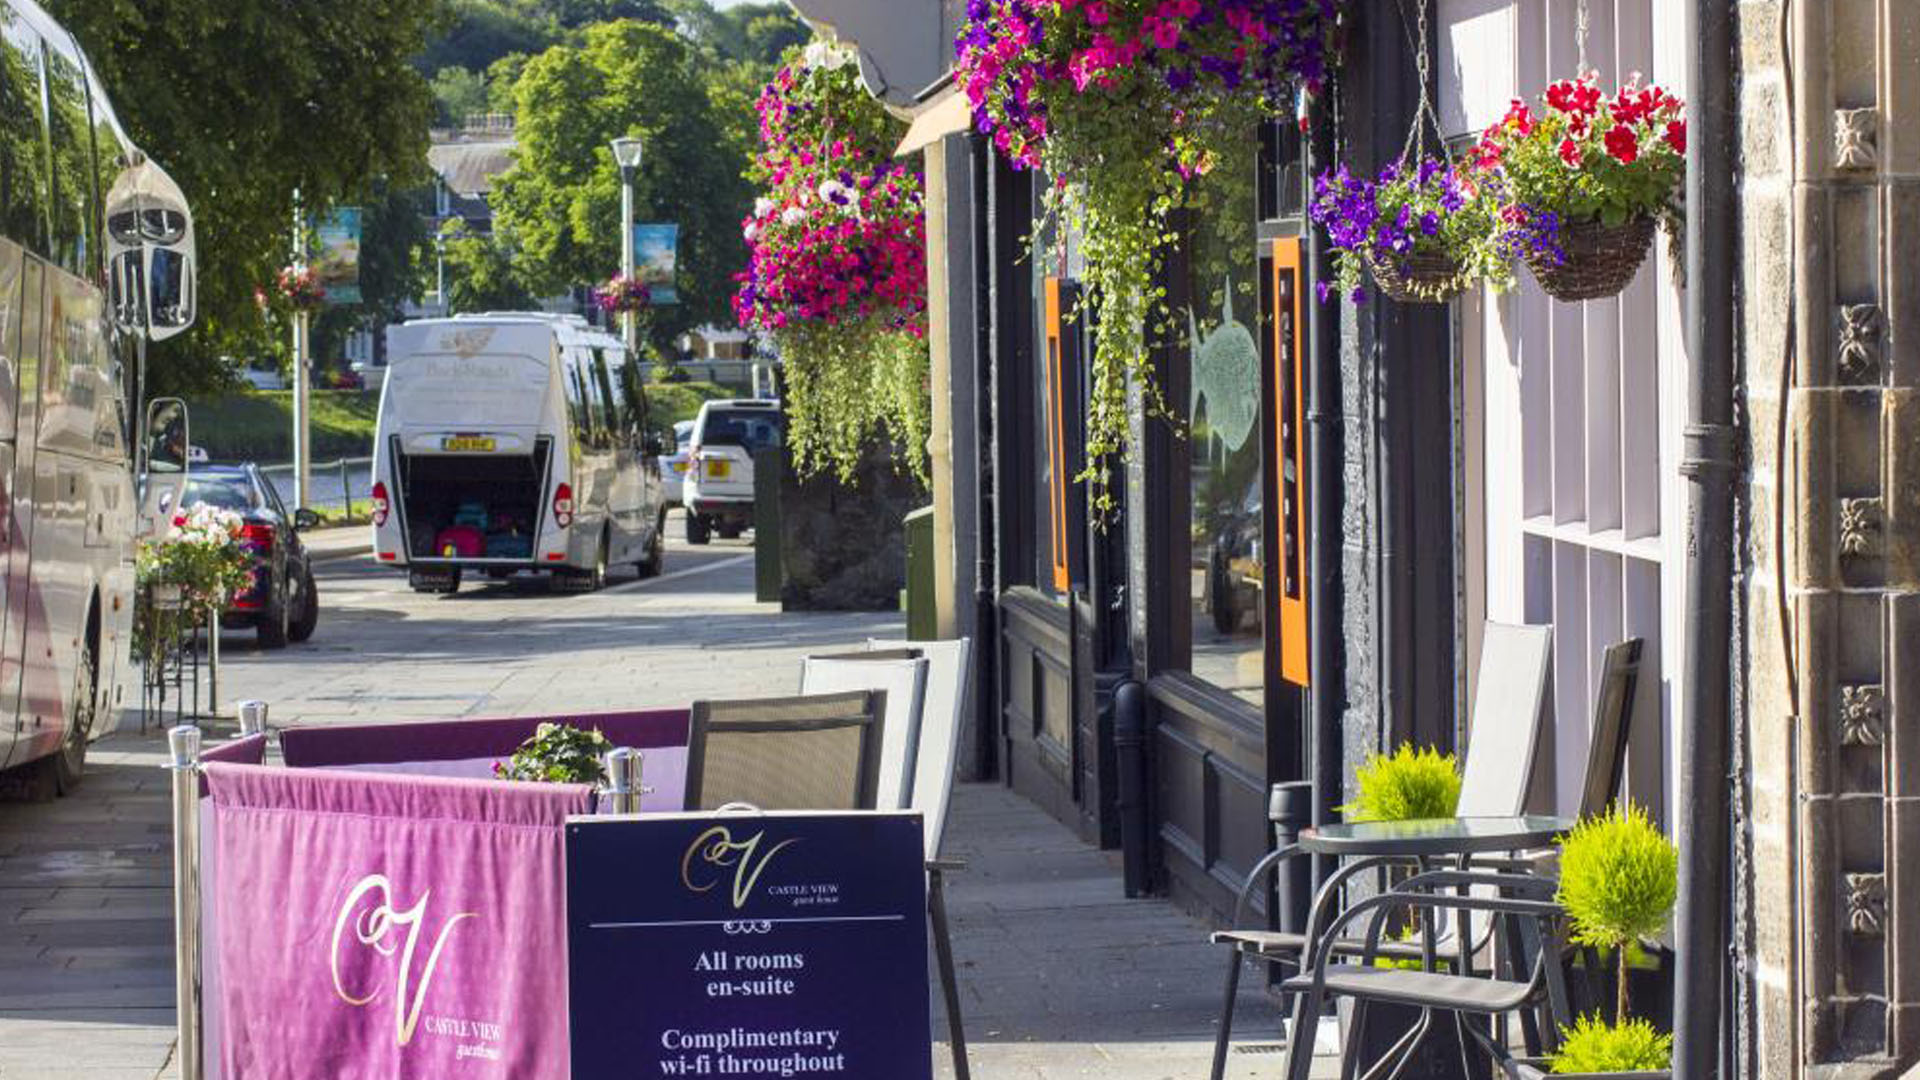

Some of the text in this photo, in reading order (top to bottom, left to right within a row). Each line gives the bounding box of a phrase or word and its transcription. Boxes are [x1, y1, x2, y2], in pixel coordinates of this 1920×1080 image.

[767, 883, 839, 896] CASTLE VIEW
[694, 951, 804, 971] All rooms
[706, 975, 795, 996] en-suite
[425, 1015, 502, 1041] CASTLE VIEW
[661, 1028, 839, 1053] Complimentary
[660, 1052, 845, 1077] wi-fi throughout
